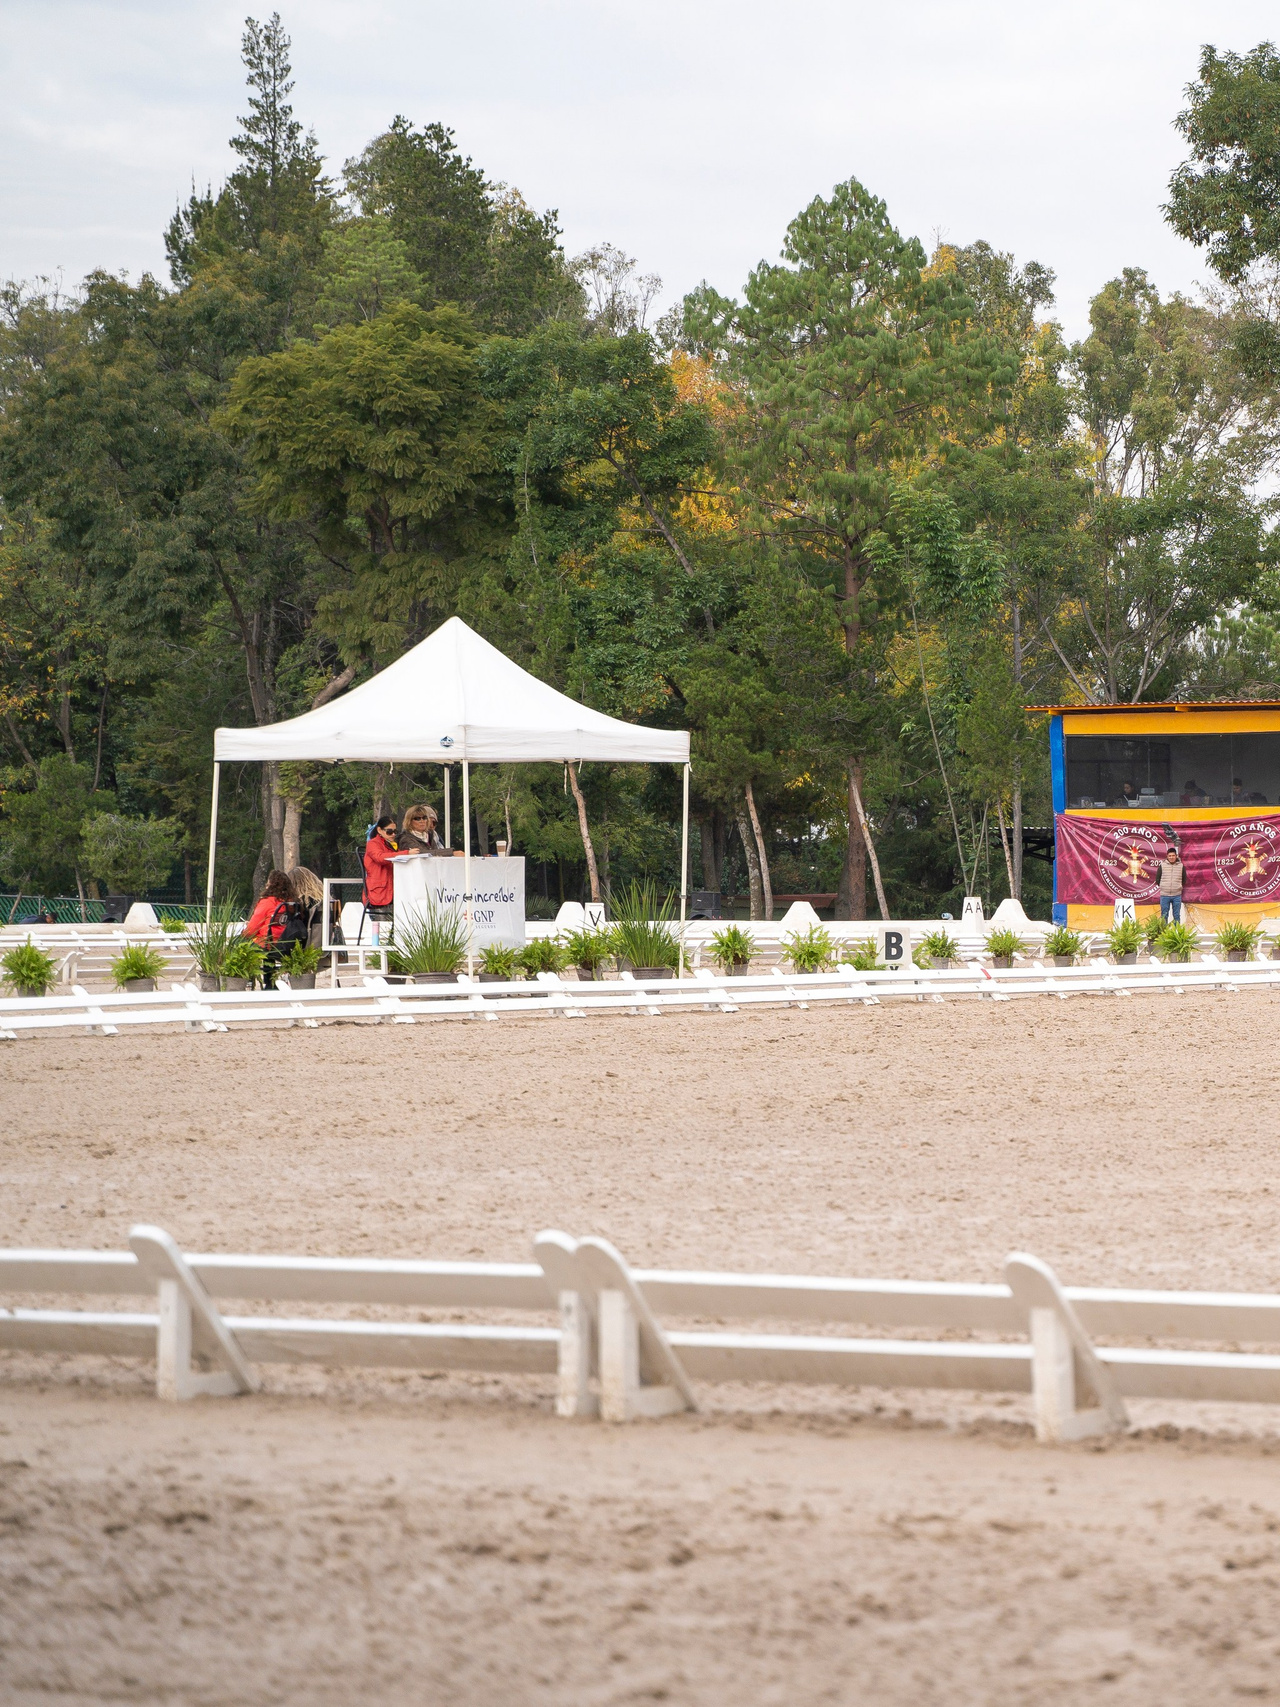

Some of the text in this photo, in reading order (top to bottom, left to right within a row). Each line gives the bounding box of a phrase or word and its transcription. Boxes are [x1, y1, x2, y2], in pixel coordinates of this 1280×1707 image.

[1113, 827, 1129, 840] 200
[1229, 822, 1277, 839] 200 AÑOS
[1100, 859, 1118, 867] 1823
[1216, 858, 1235, 866] 1823
[436, 887, 460, 903] Vivir
[1239, 888, 1267, 896] COLEGIO
[964, 902, 973, 914] A
[975, 901, 983, 913] A
[1122, 904, 1132, 918] K
[474, 910, 494, 923] GNP
[589, 910, 602, 927] V
[884, 931, 903, 961] B
